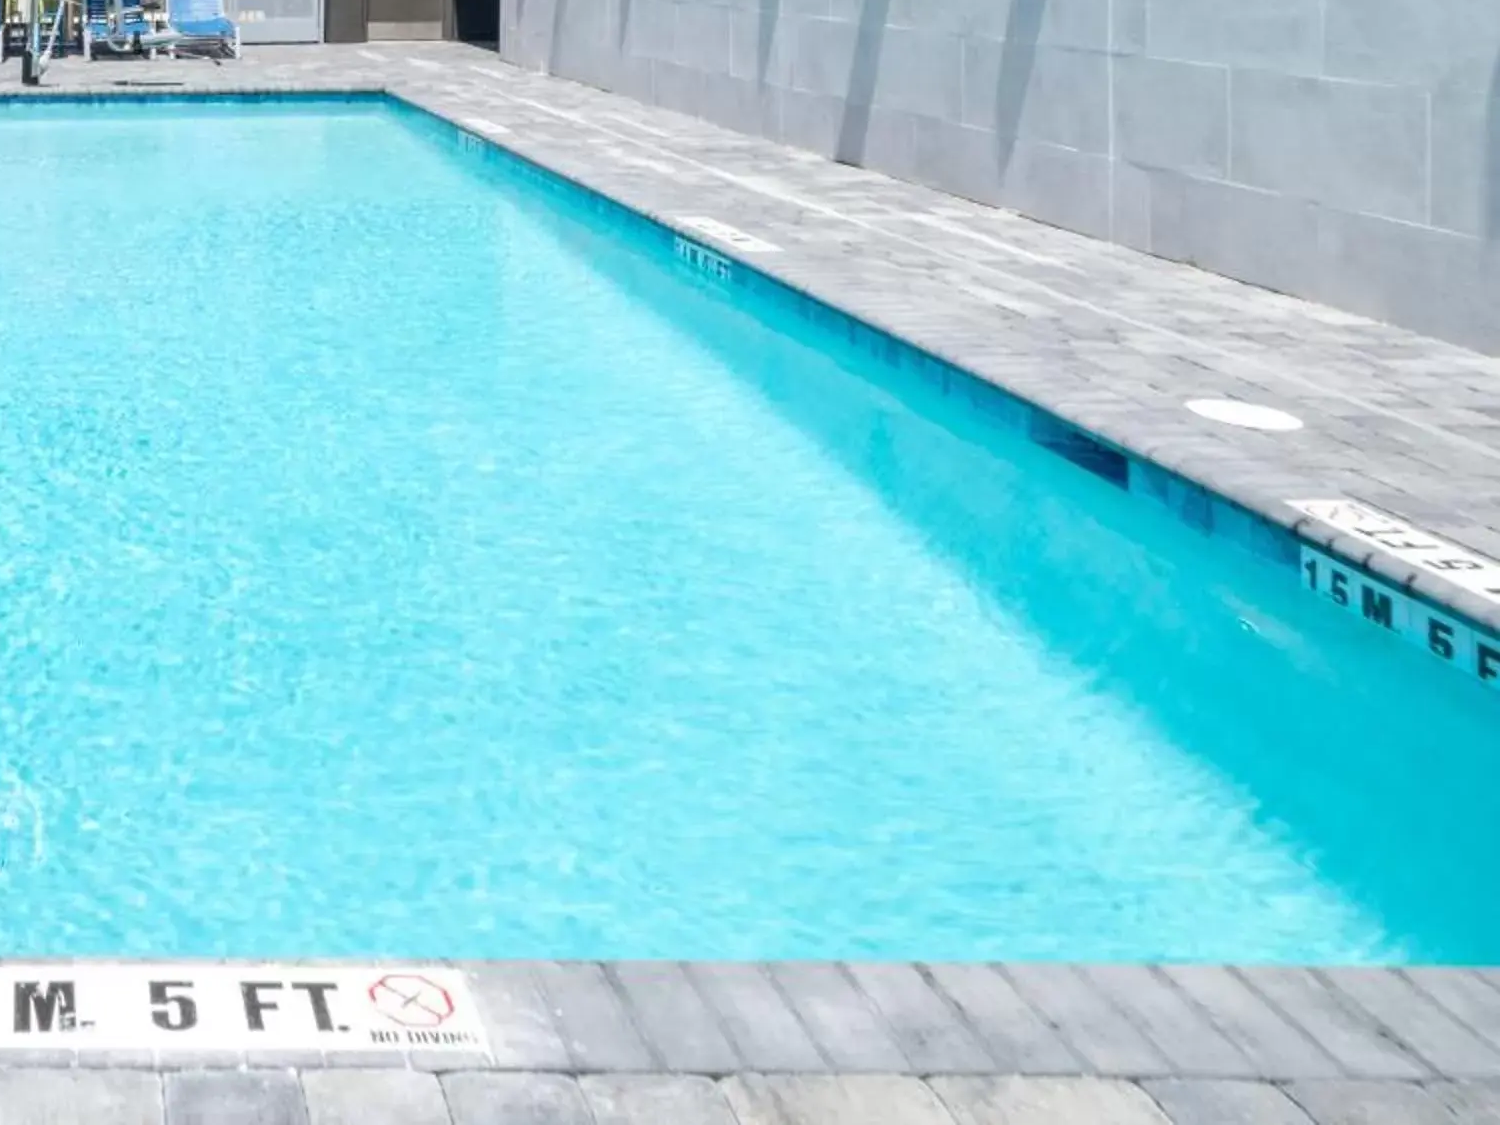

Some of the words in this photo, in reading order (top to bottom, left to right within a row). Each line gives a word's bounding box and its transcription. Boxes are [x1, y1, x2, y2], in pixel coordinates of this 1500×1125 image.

[1427, 616, 1454, 661] 5
[148, 980, 198, 1032] 5
[238, 980, 351, 1032] FT.
[369, 1028, 400, 1044] NO
[406, 1029, 479, 1045] DIVING
